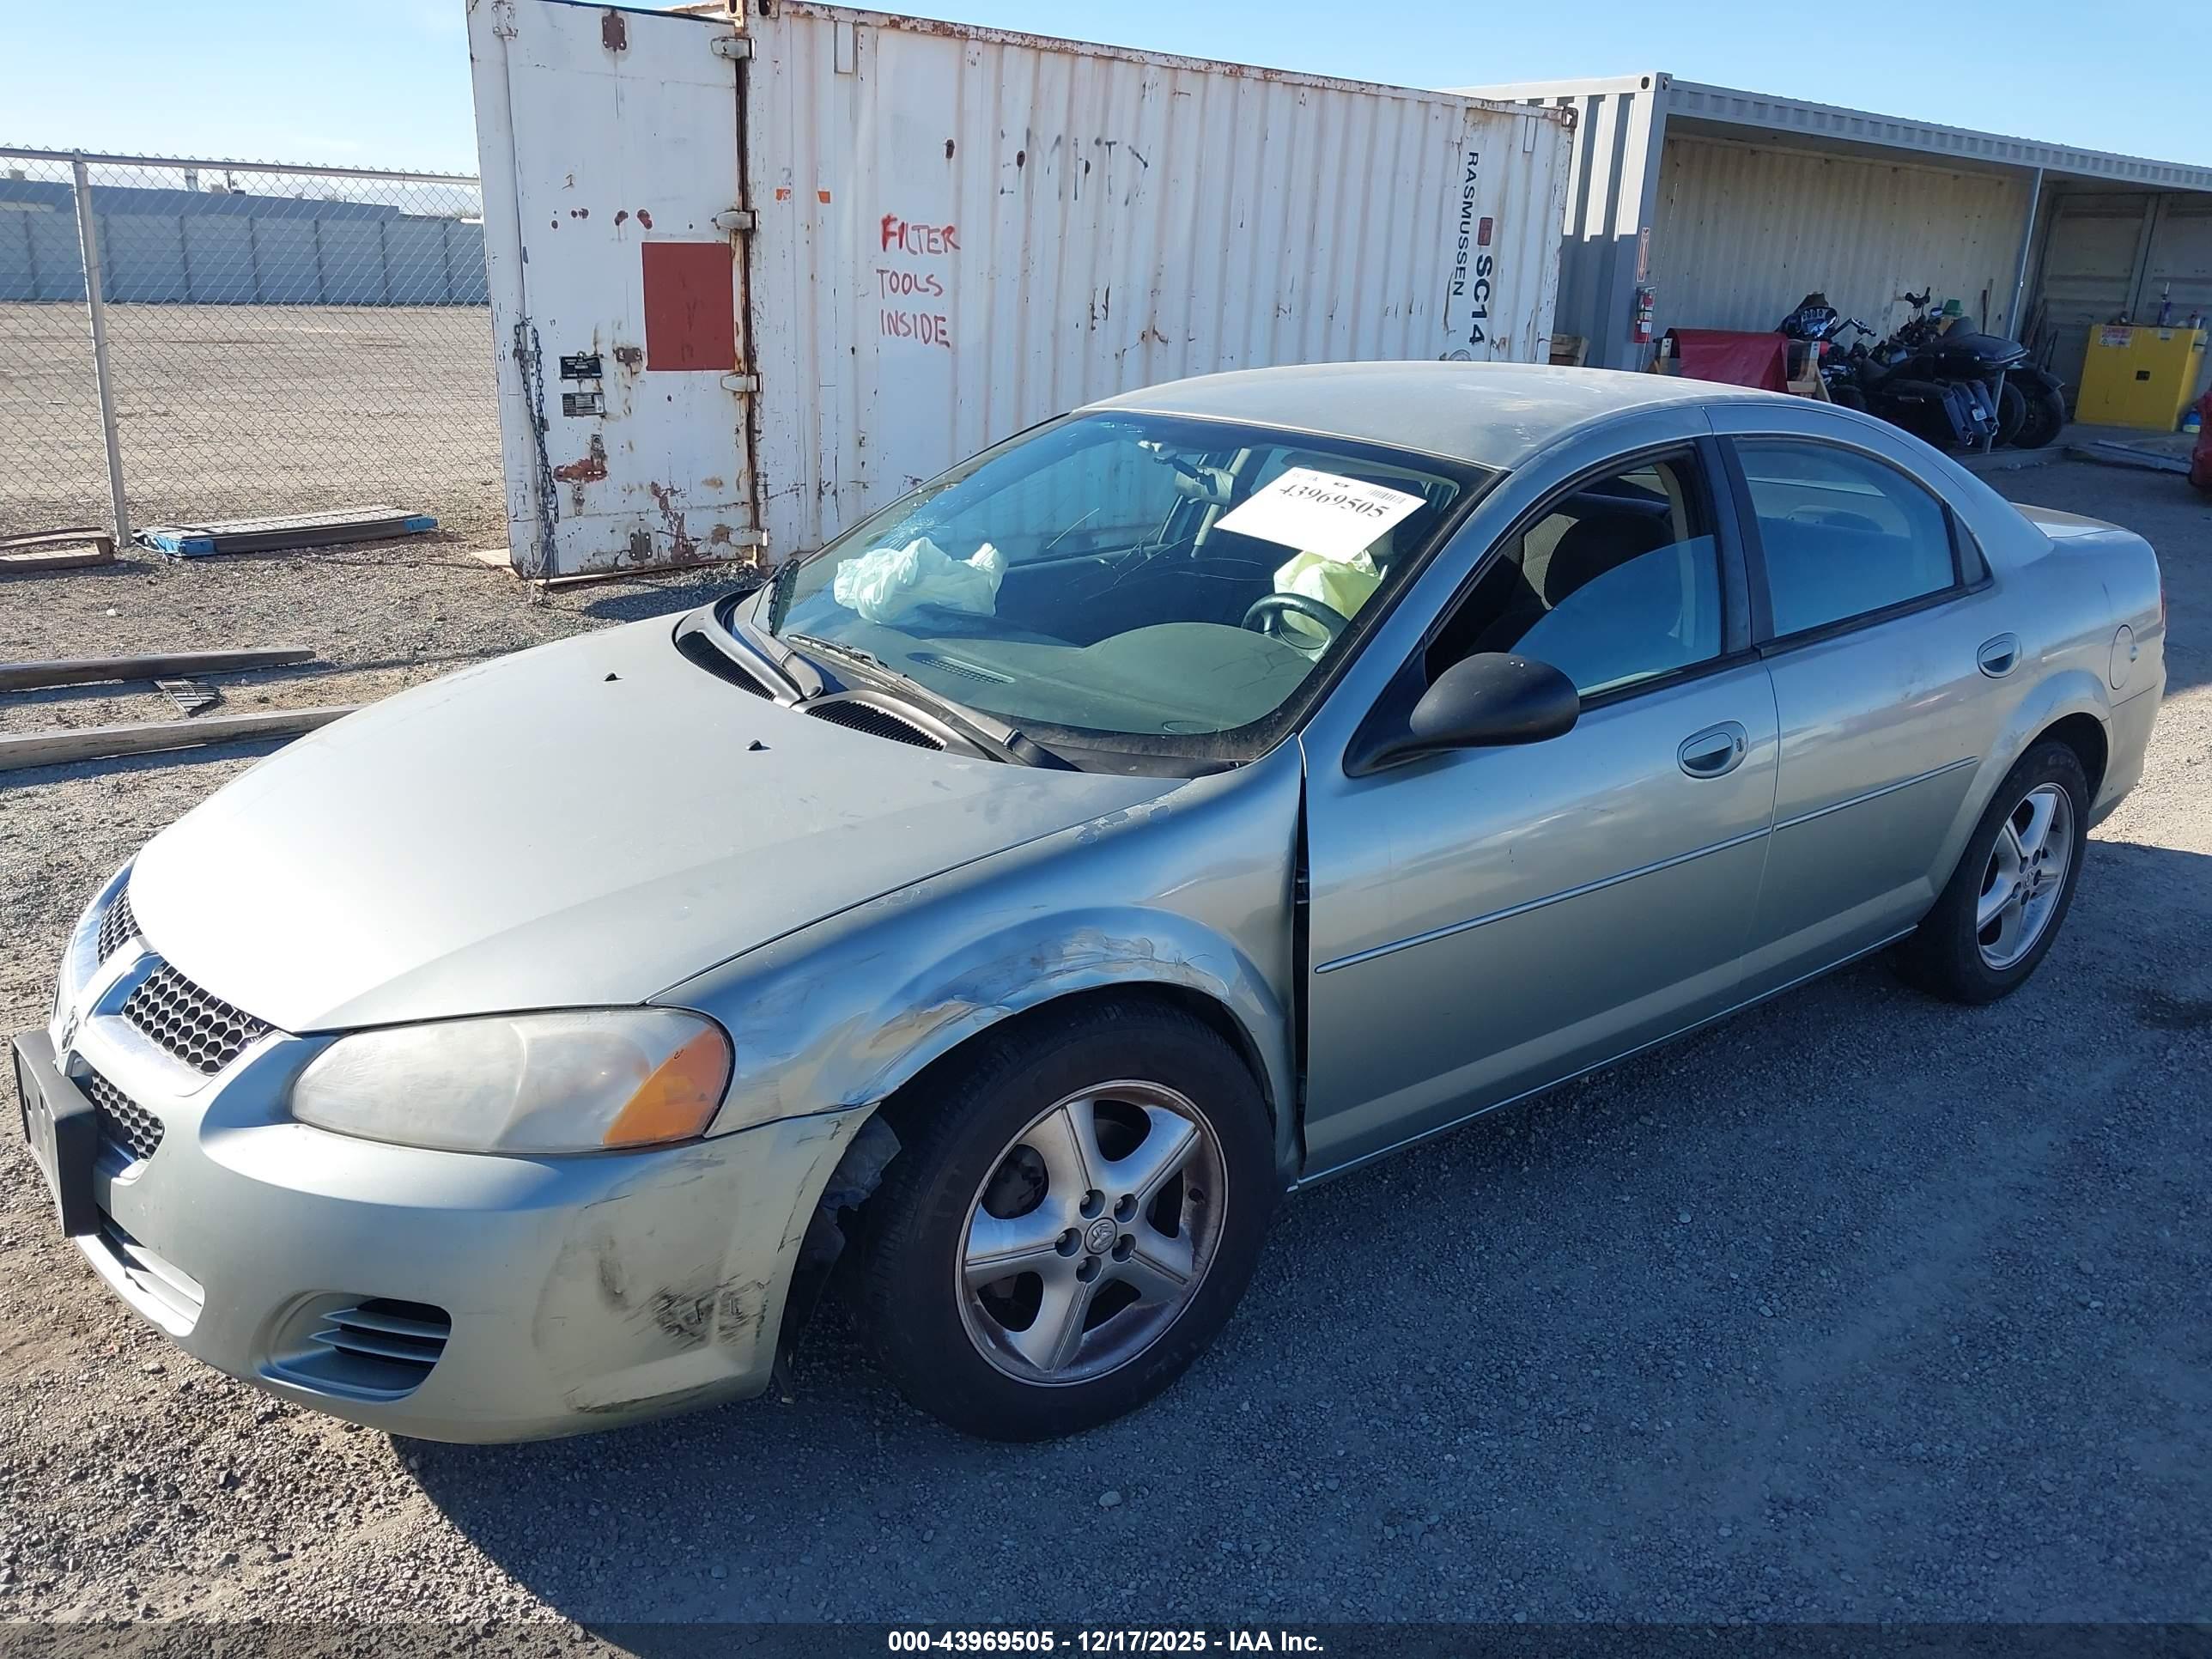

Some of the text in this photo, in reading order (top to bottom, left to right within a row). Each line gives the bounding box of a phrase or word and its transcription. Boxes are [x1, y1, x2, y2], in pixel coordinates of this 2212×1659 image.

[881, 213, 961, 256] FILTER
[1452, 151, 1479, 296] RASMUSSEN
[876, 269, 944, 300] TOOLS
[1468, 254, 1493, 346] SC14
[880, 309, 951, 348] INSIDE
[1279, 483, 1390, 518] 43969505
